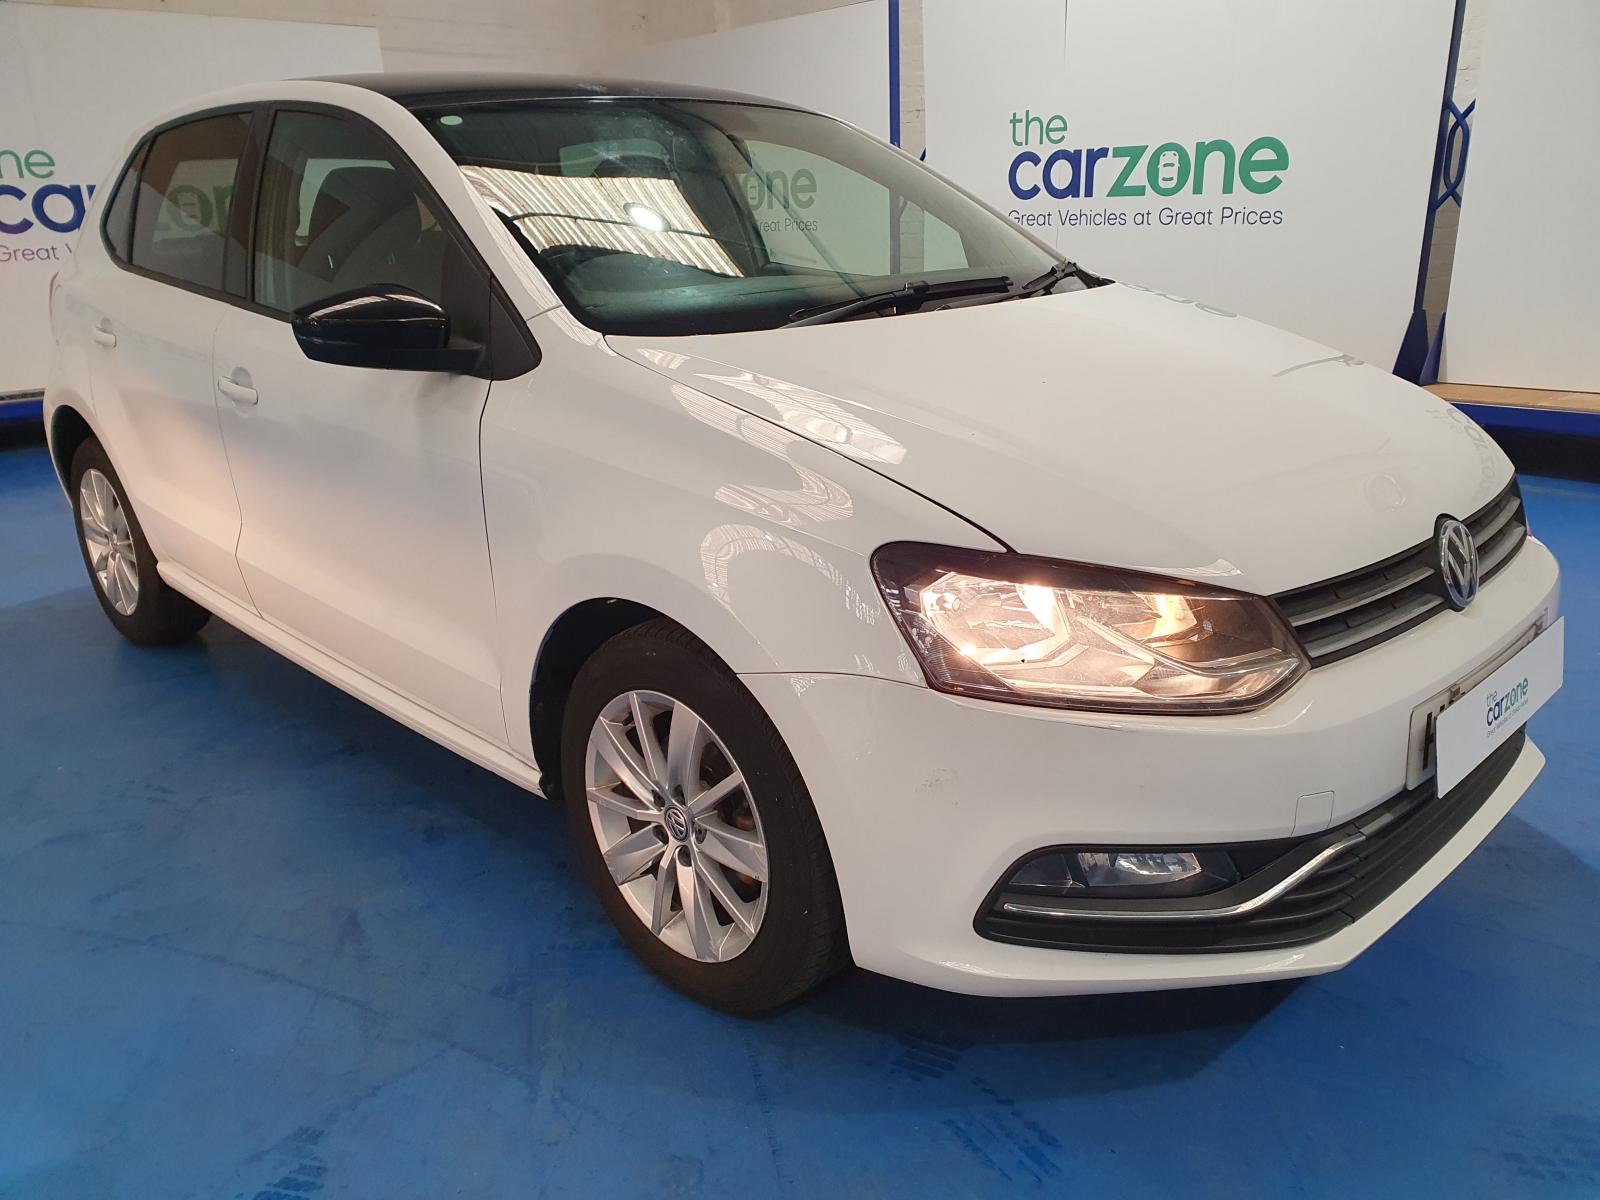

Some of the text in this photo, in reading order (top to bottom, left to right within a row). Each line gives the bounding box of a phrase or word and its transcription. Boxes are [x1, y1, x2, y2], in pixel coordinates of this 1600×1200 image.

[1009, 109, 1068, 147] the
[1008, 136, 1290, 201] carzone
[1058, 208, 1127, 227] Vehicles
[1133, 209, 1152, 226] at
[1158, 207, 1213, 226] Great
[1220, 206, 1284, 225] Prices
[1486, 677, 1529, 727] carzone
